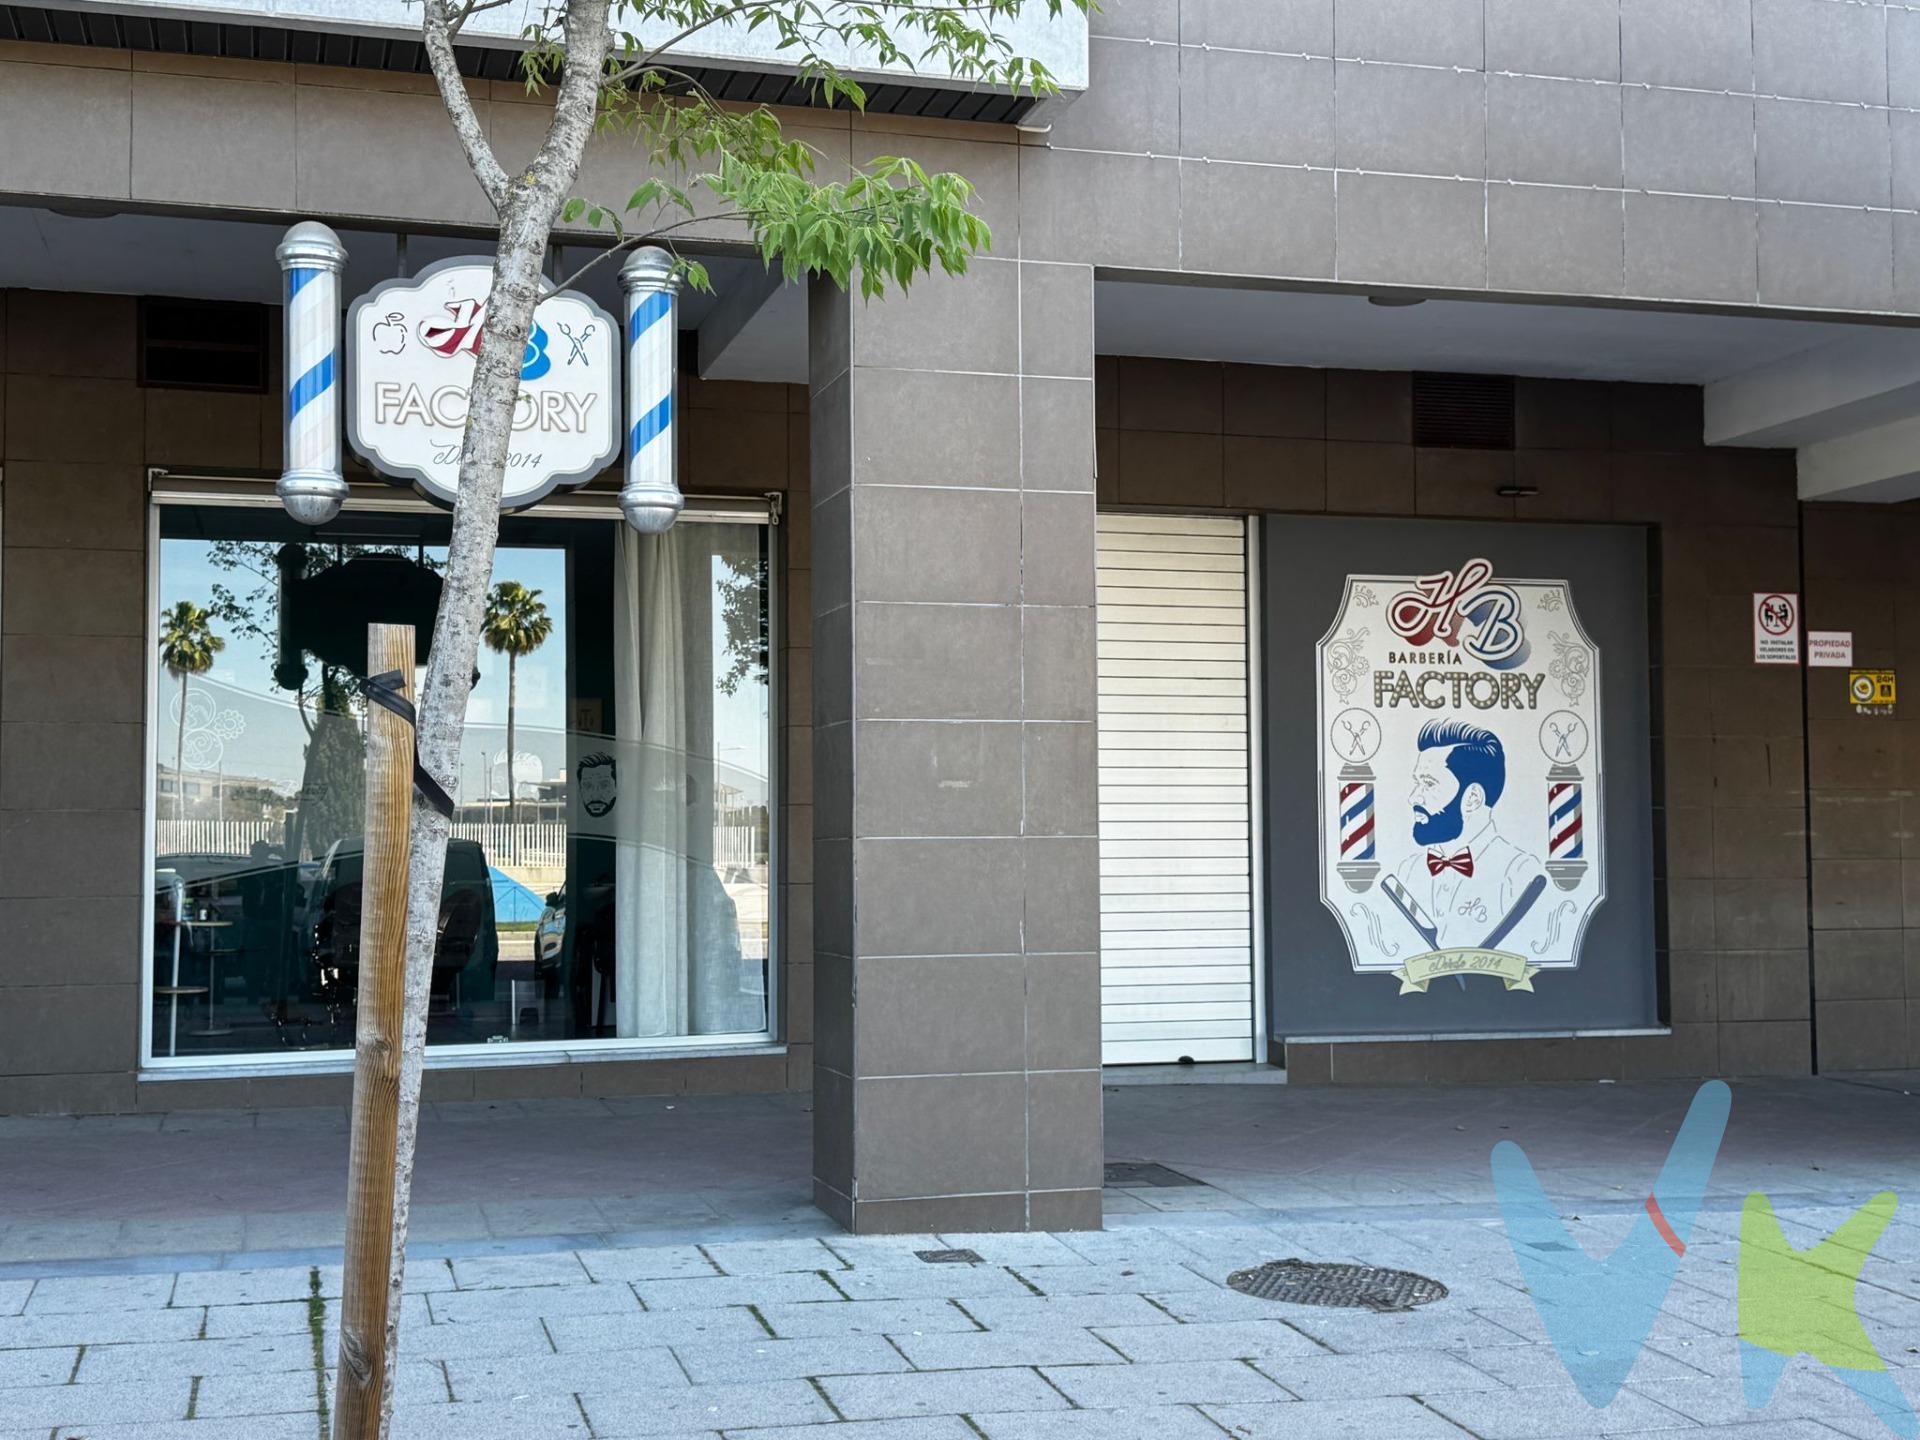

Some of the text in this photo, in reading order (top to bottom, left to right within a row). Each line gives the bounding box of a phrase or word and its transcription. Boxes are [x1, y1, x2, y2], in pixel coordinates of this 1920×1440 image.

[374, 382, 598, 433] FACORY
[1386, 558, 1526, 665] HB
[1808, 639, 1851, 648] PROPIEDAD
[1814, 651, 1847, 659] PRIVADA
[1373, 670, 1545, 710] FACTORY
[1469, 955, 1503, 970] 2014
